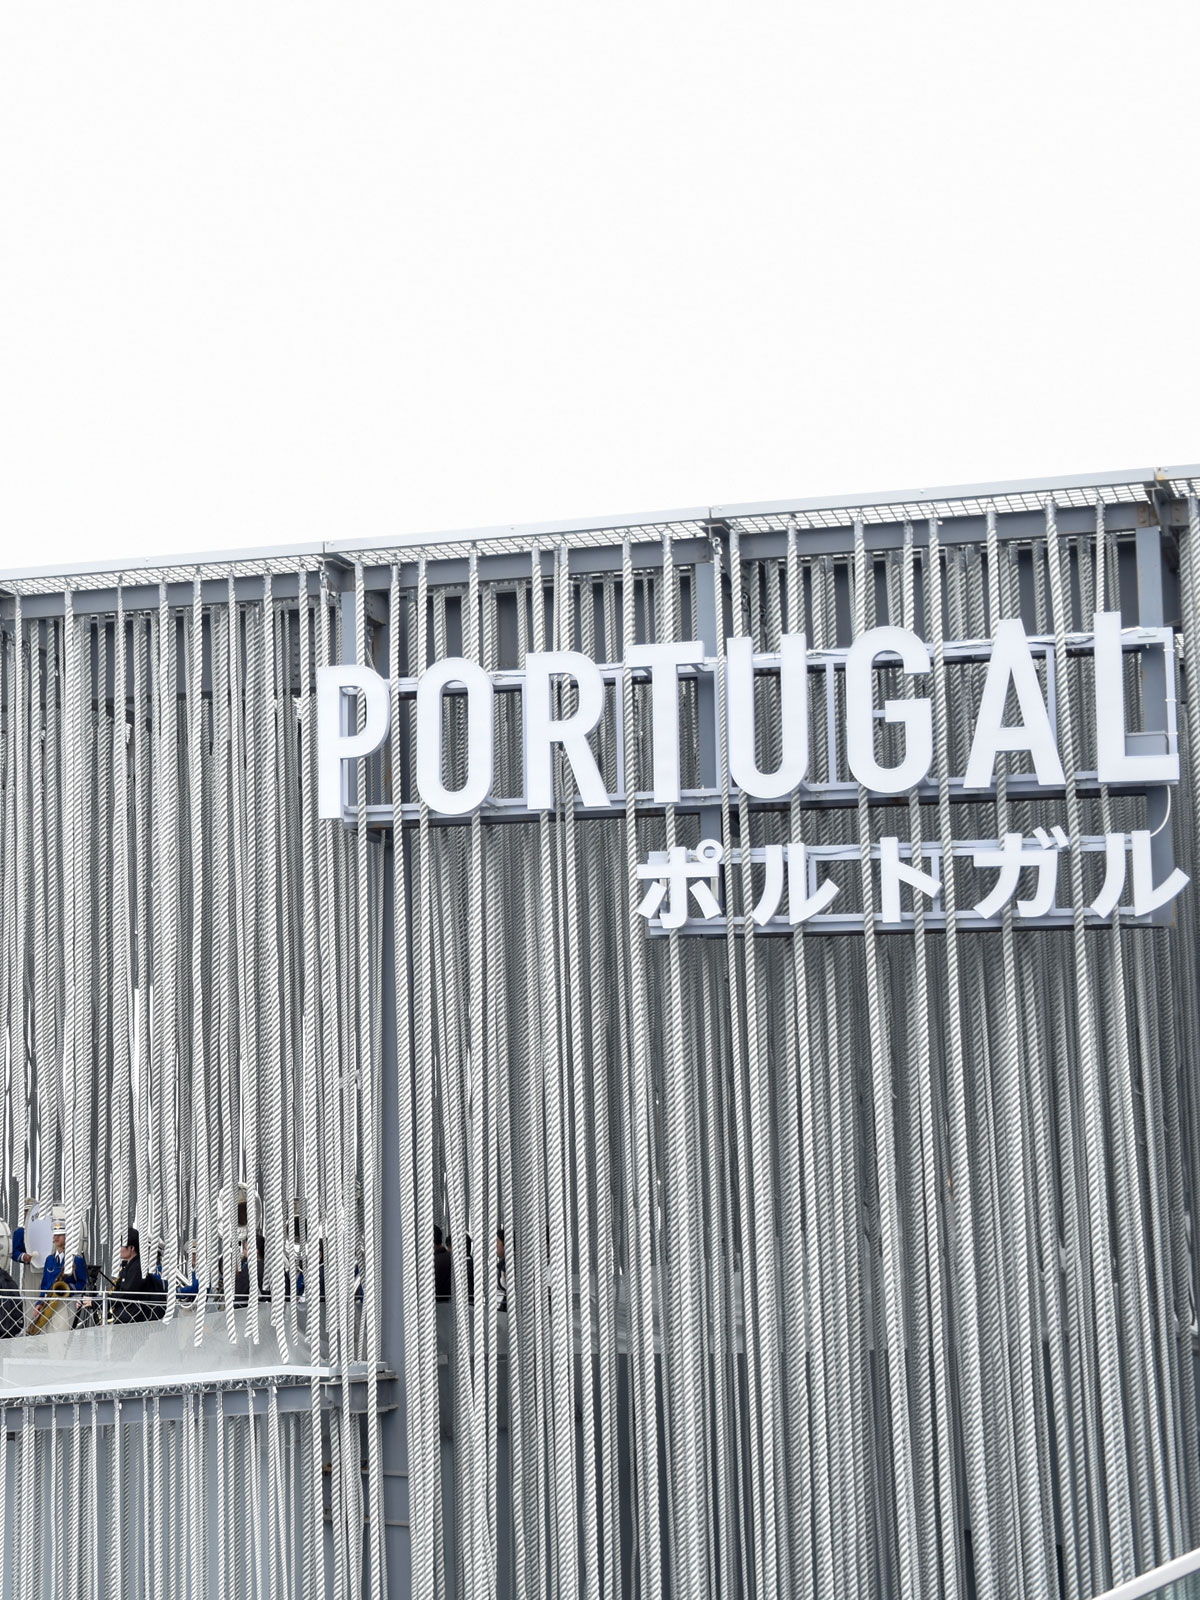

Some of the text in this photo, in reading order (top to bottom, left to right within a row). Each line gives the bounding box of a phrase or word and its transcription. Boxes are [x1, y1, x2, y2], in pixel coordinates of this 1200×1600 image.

[316, 612, 1180, 819] PORTUGAL
[637, 826, 1189, 929] ポルトガル
